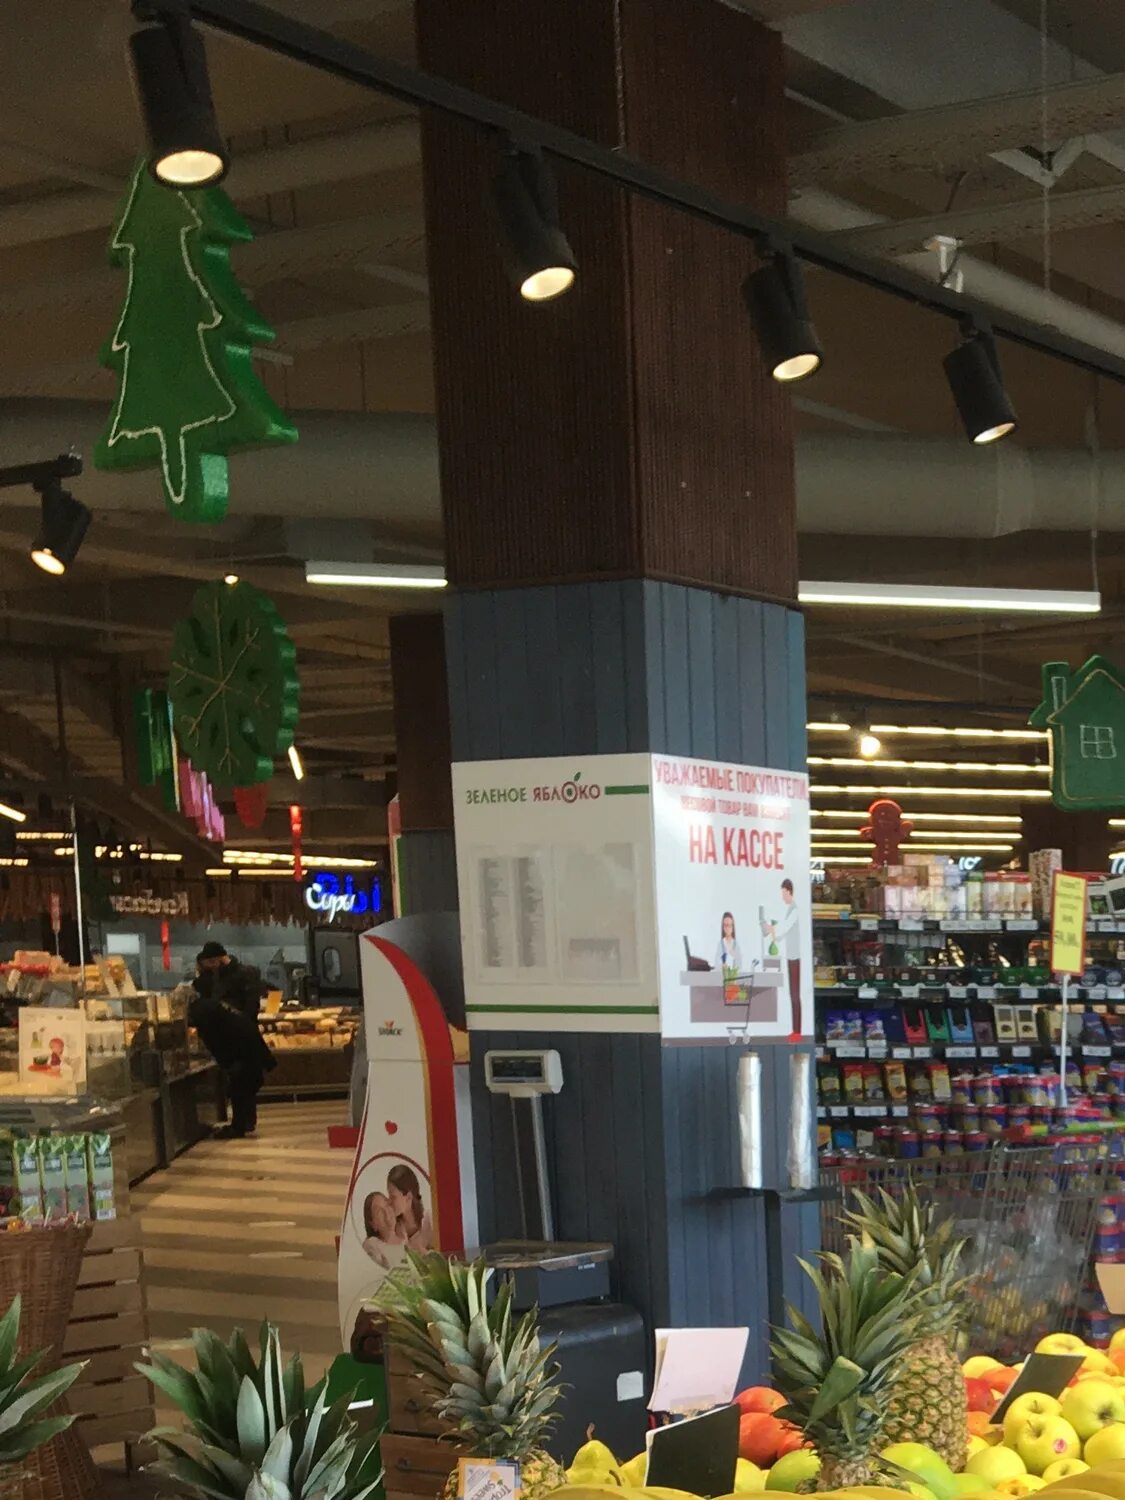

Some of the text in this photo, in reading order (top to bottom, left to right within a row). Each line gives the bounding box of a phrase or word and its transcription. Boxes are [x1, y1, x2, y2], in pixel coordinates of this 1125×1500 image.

[654, 760, 734, 791] УВАЖАЕМЫЕ
[466, 781, 601, 805] ЗЕЛЕНОЕ ЯБЛОКО
[689, 825, 785, 871] НА КАССЕ
